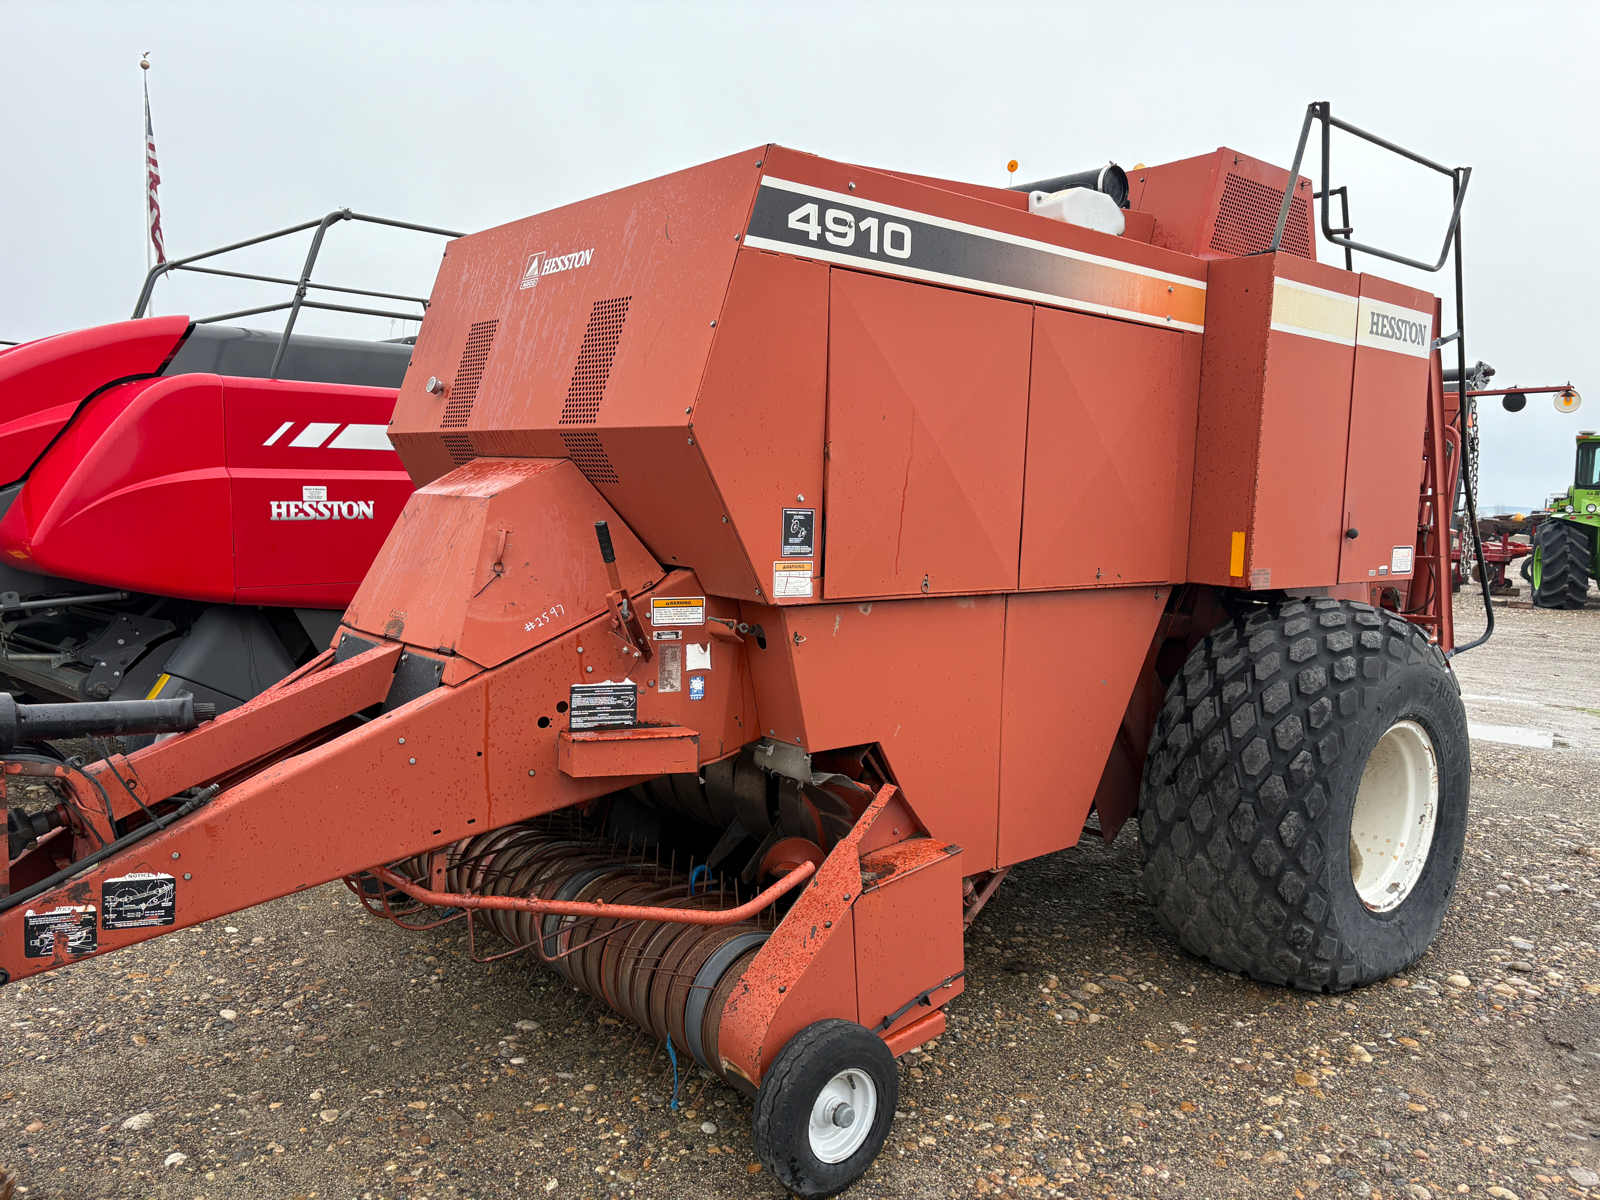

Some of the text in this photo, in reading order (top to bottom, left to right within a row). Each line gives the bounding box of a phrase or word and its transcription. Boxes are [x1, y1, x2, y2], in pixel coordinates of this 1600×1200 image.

[788, 202, 912, 259] 4910
[541, 248, 595, 276] HESSTON
[1369, 311, 1427, 347] HESSTON
[270, 501, 374, 521] HESSTON
[524, 603, 565, 632] #2597
